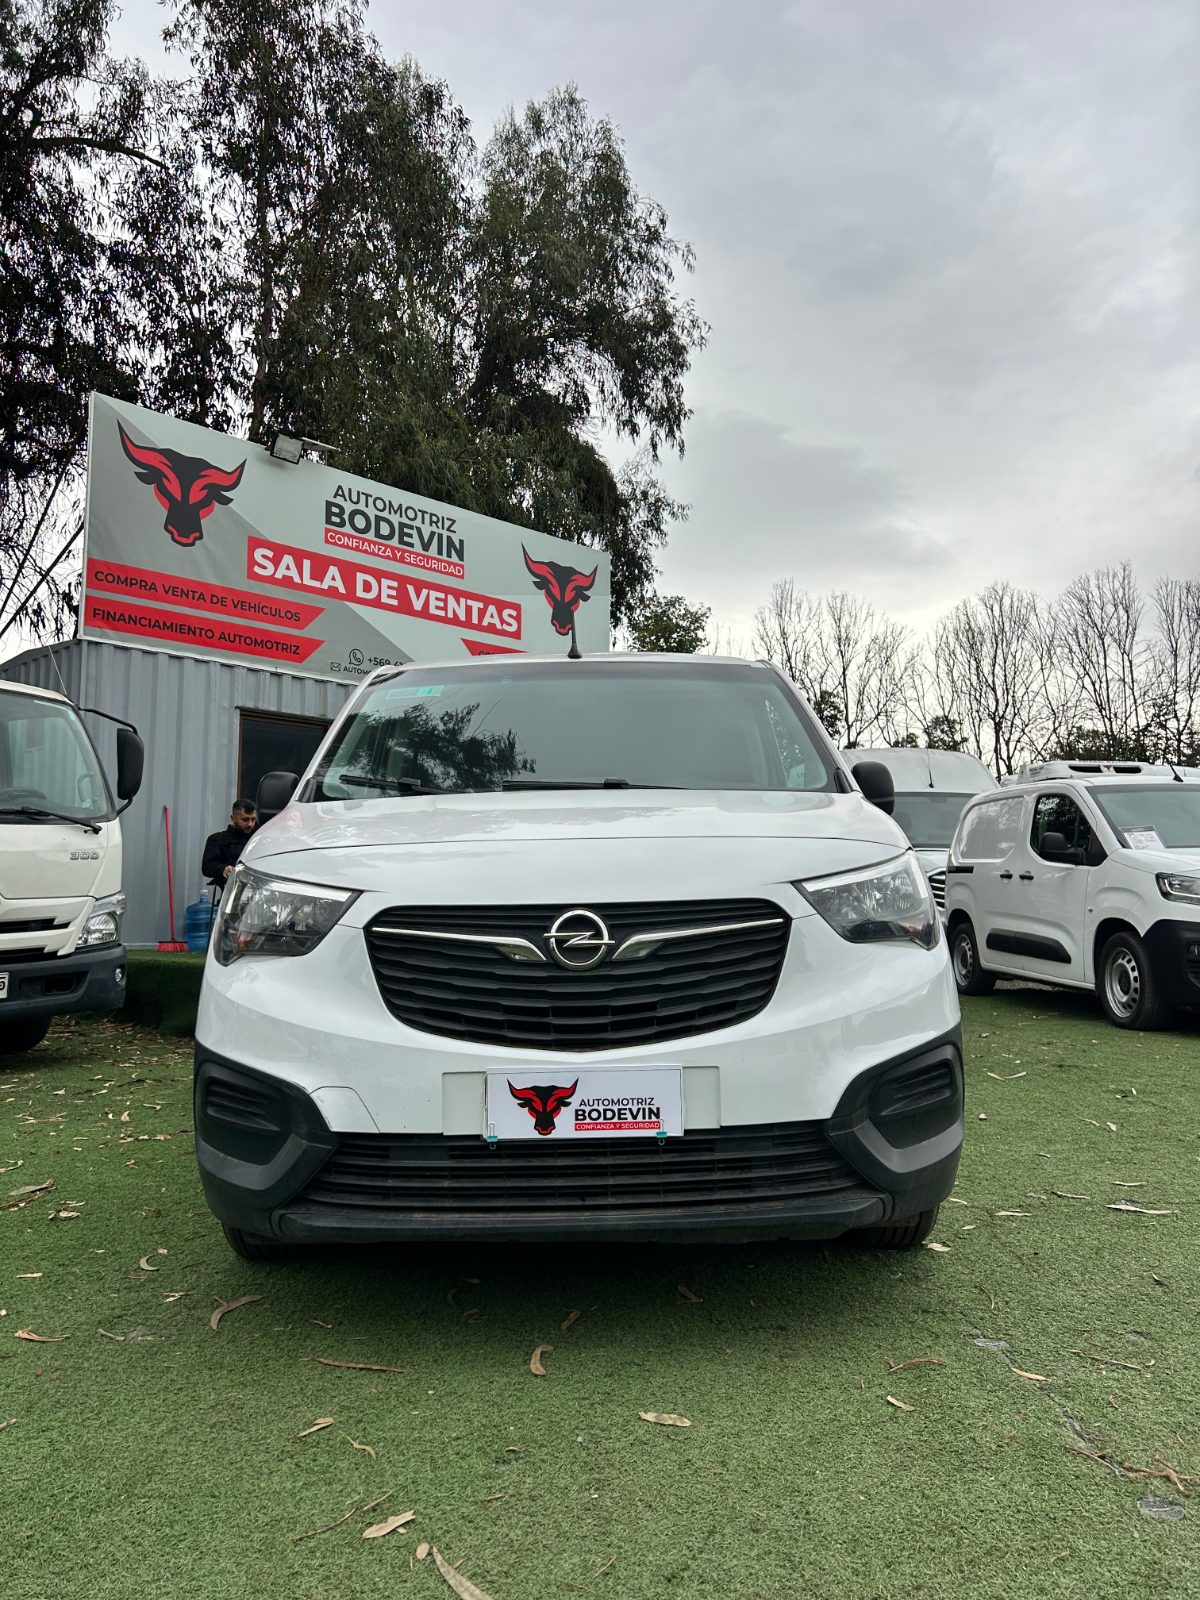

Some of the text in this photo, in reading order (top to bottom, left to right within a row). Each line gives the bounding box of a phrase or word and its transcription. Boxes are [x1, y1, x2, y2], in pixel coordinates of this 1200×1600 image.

[325, 500, 464, 562] BODEVIN
[333, 484, 457, 533] AUTOMOTRIZ
[327, 532, 463, 576] CONFIANZA Y SEGURIDAD
[94, 570, 301, 622] COMPRA VENTA DE VEHÍCULOS
[253, 547, 519, 632] SALA DE VENTAS
[92, 607, 301, 655] FINANCIAMIENTO AUTOMOTRIZ
[575, 1107, 660, 1121] BODEVIN
[579, 1097, 655, 1107] AUTOMOTRIZ
